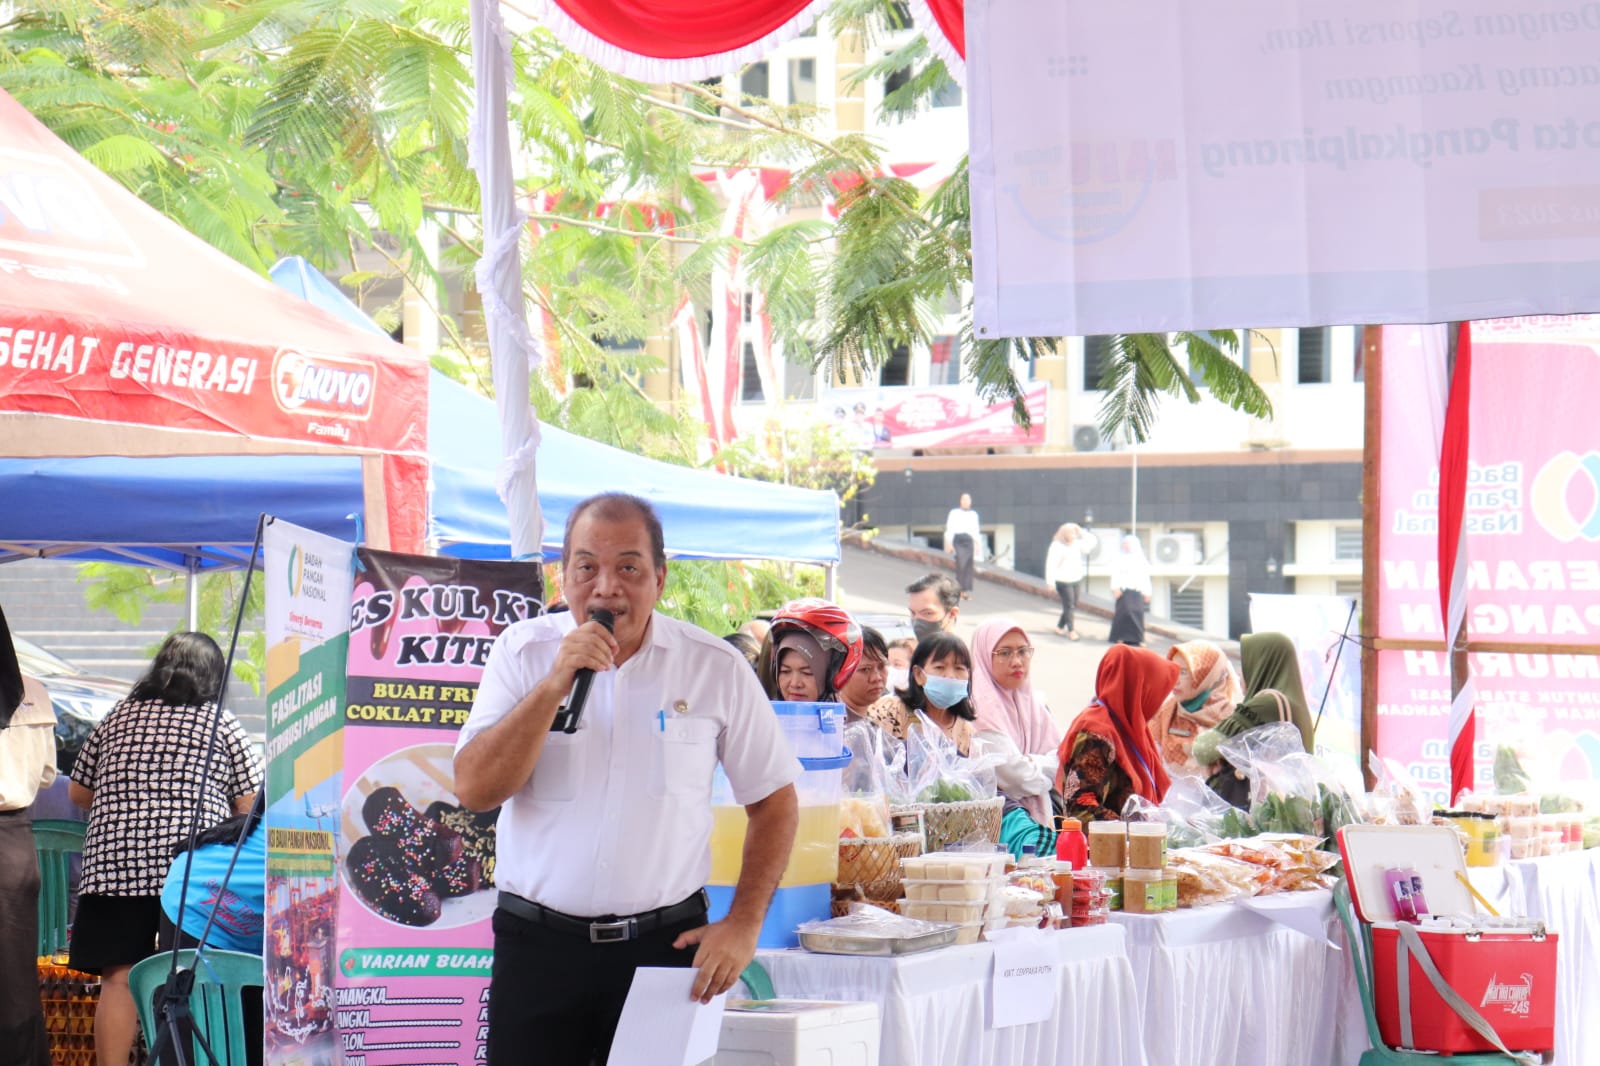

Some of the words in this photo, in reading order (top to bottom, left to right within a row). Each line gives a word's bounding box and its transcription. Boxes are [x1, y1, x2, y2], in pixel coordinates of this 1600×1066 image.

[110, 341, 258, 396] GENERASI
[301, 364, 372, 407] NUVO
[307, 421, 351, 442] Family
[302, 585, 327, 602] NASIONAL
[400, 585, 489, 622] KUL
[271, 671, 322, 729] FASILITASI
[373, 683, 435, 700] BUAH
[303, 695, 337, 735] PANGAN
[346, 704, 435, 722] COKLAT
[361, 954, 431, 969] VARIAN
[436, 954, 494, 969] BUAH
